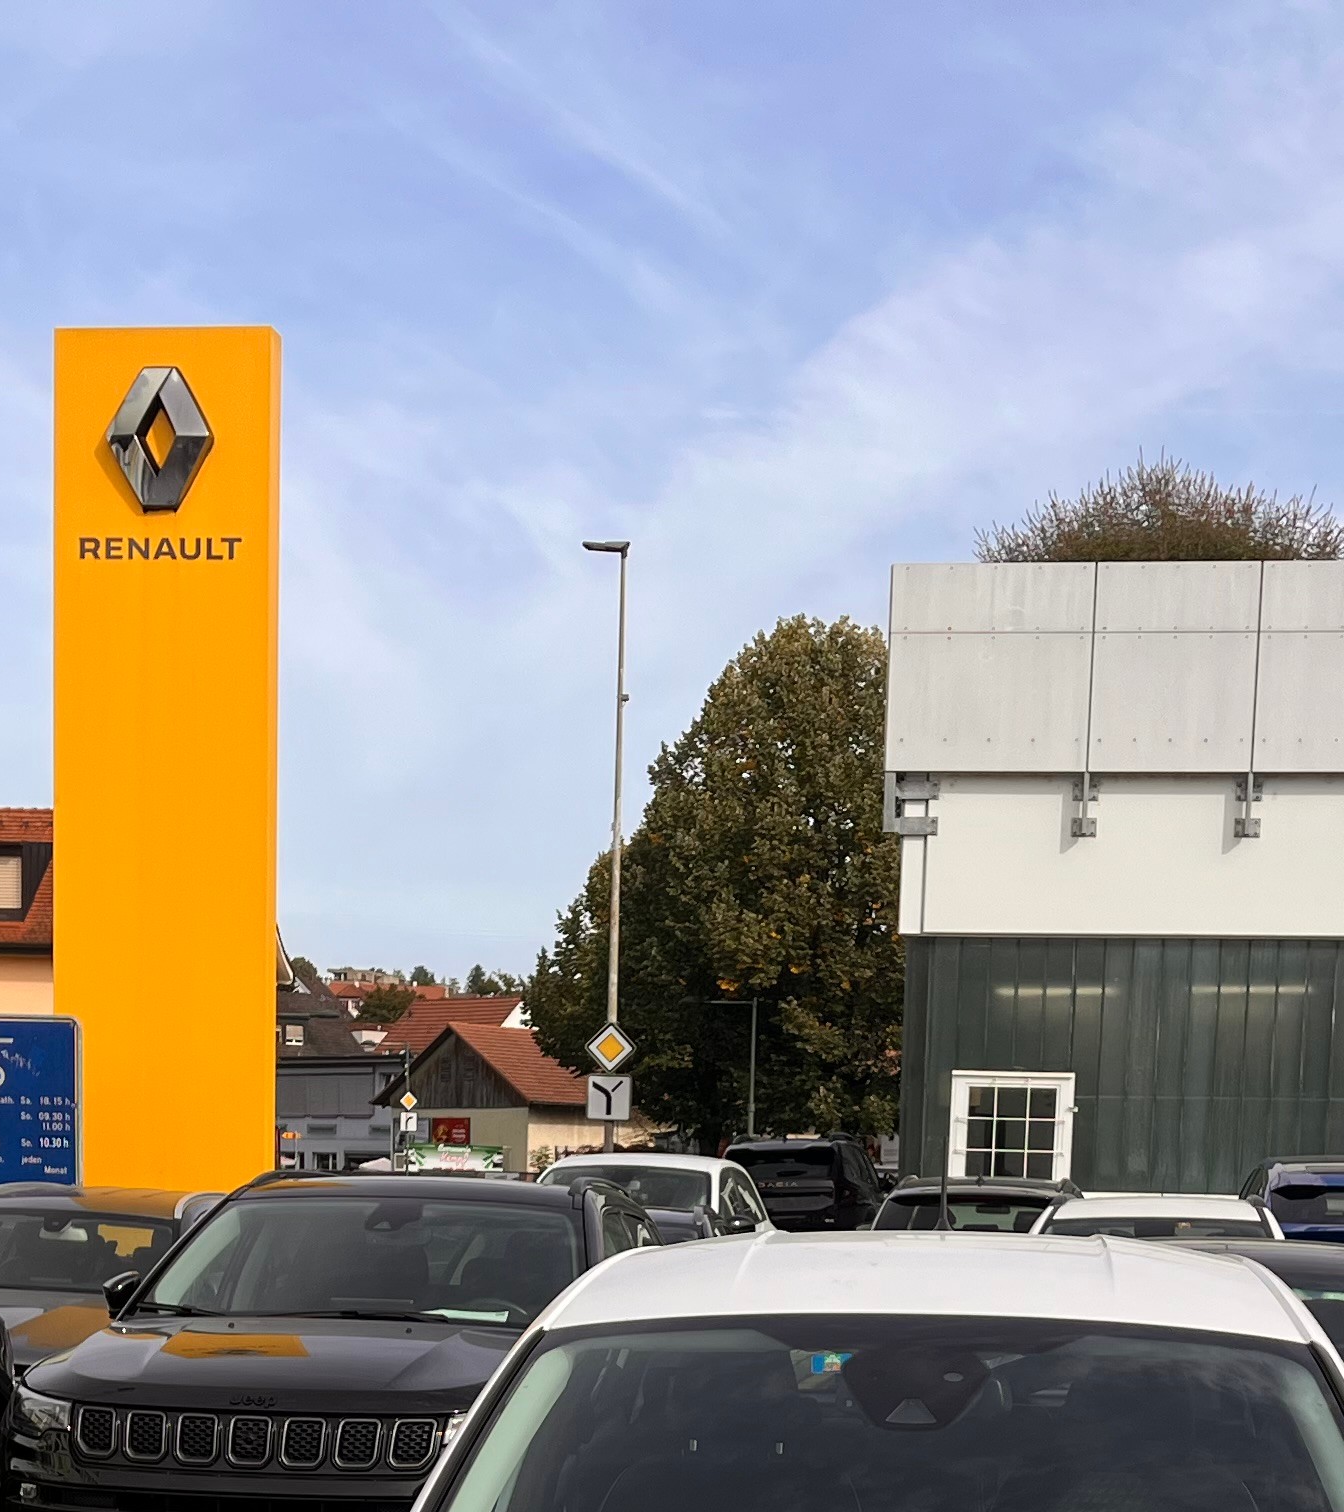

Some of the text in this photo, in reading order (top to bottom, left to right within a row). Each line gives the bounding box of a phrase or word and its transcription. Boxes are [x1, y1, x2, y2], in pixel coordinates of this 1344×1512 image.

[79, 537, 242, 560] RENAULT
[65, 1112, 71, 1121] h
[65, 1123, 71, 1132] h
[39, 1137, 62, 1148] 10.30
[63, 1137, 69, 1148] h
[43, 1165, 68, 1175] Monat
